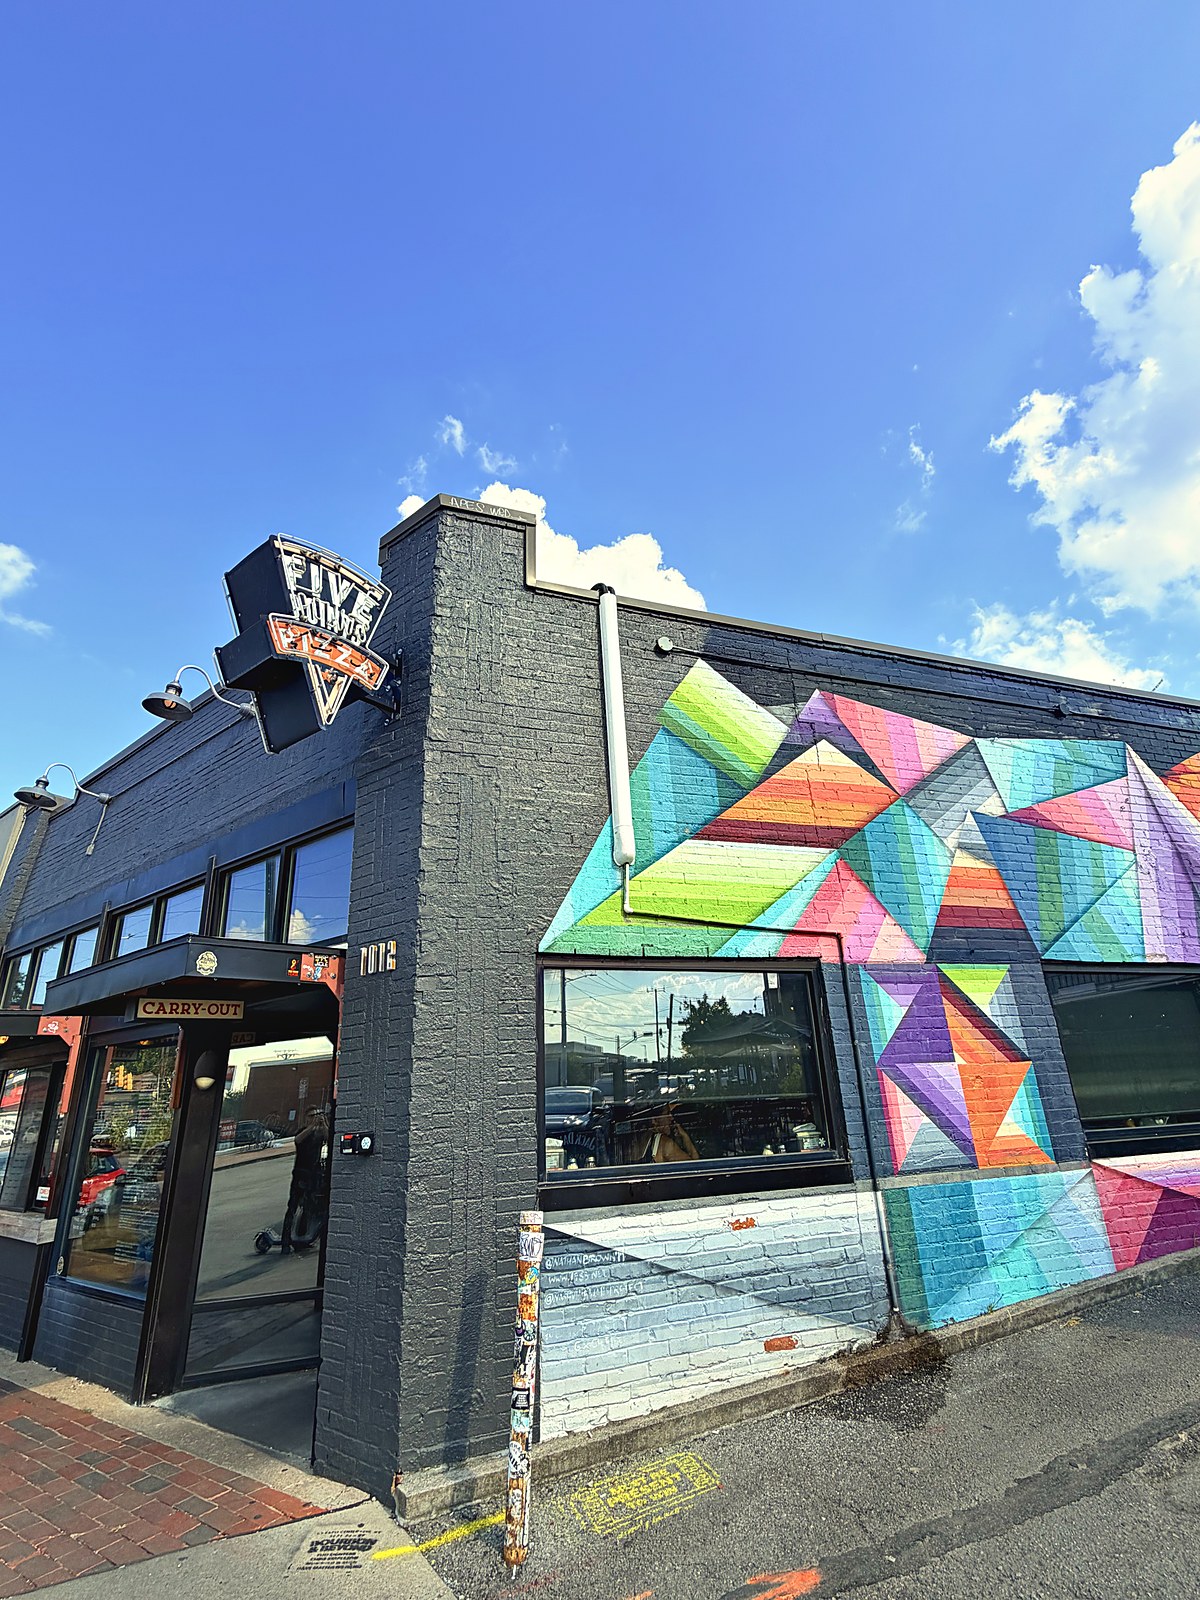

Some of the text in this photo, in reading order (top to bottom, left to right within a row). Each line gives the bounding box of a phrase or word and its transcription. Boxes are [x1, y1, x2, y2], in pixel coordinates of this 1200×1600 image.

[281, 553, 381, 623] FIVE
[289, 592, 371, 648] POINTS
[279, 624, 376, 686] PIZZA
[360, 940, 397, 976] 1012
[142, 1001, 241, 1016] CARRY-OUT
[607, 1472, 682, 1507] PRESENT
